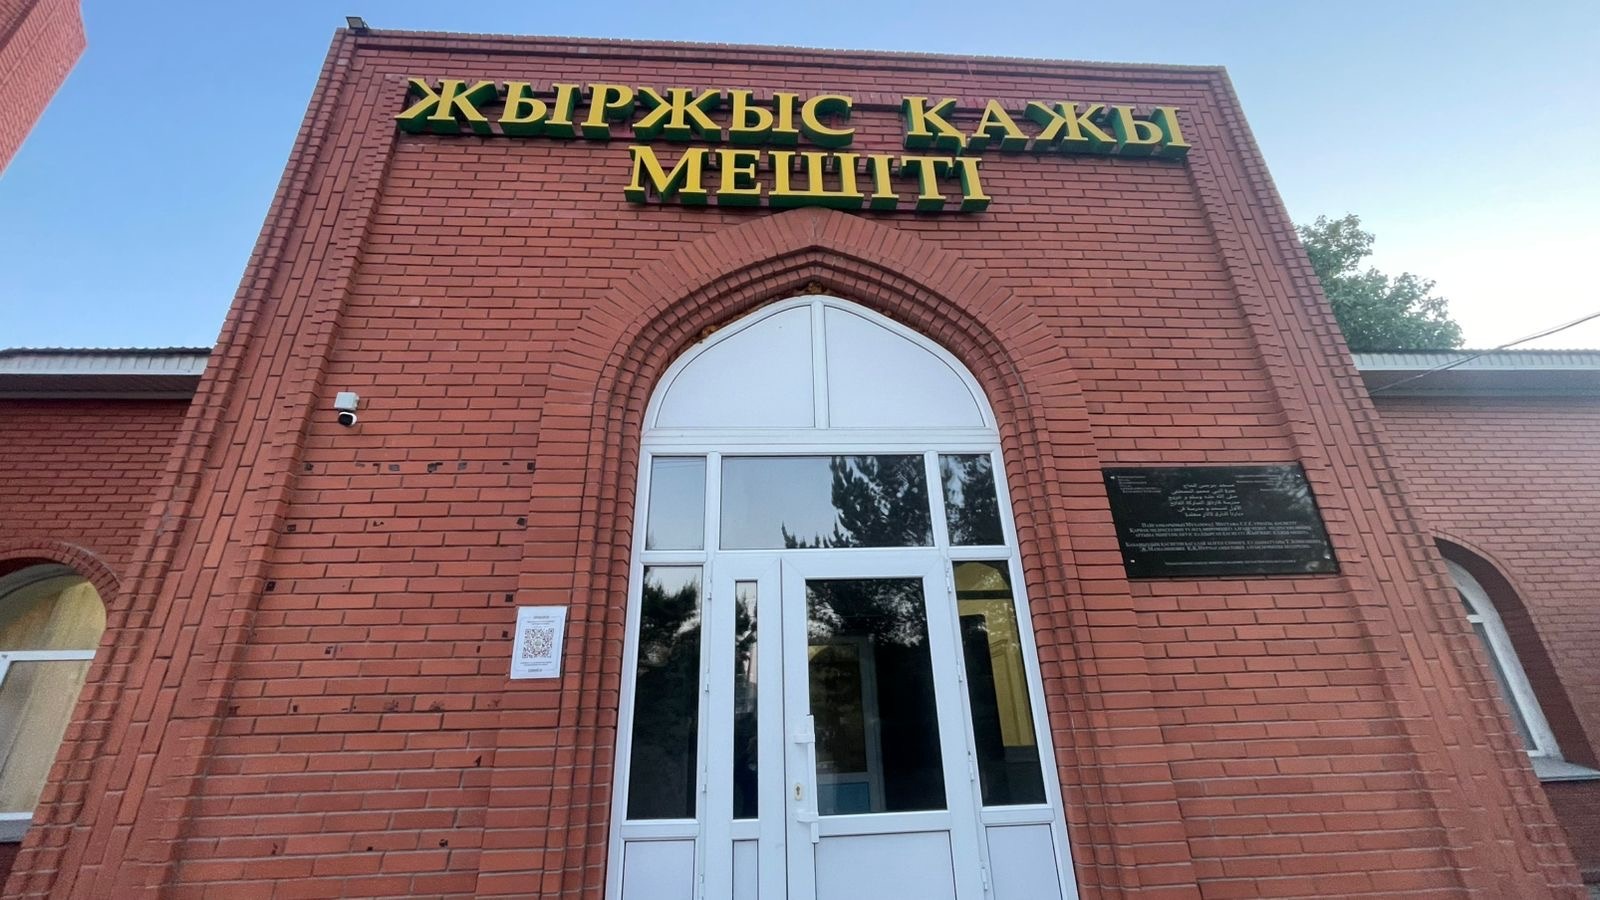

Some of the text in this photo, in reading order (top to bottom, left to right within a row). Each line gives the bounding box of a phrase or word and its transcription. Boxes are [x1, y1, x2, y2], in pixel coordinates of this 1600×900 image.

[394, 77, 1192, 148] ЖЫРЖЫС ҚАЖЫ
[623, 145, 992, 200] МЕШІТІ
